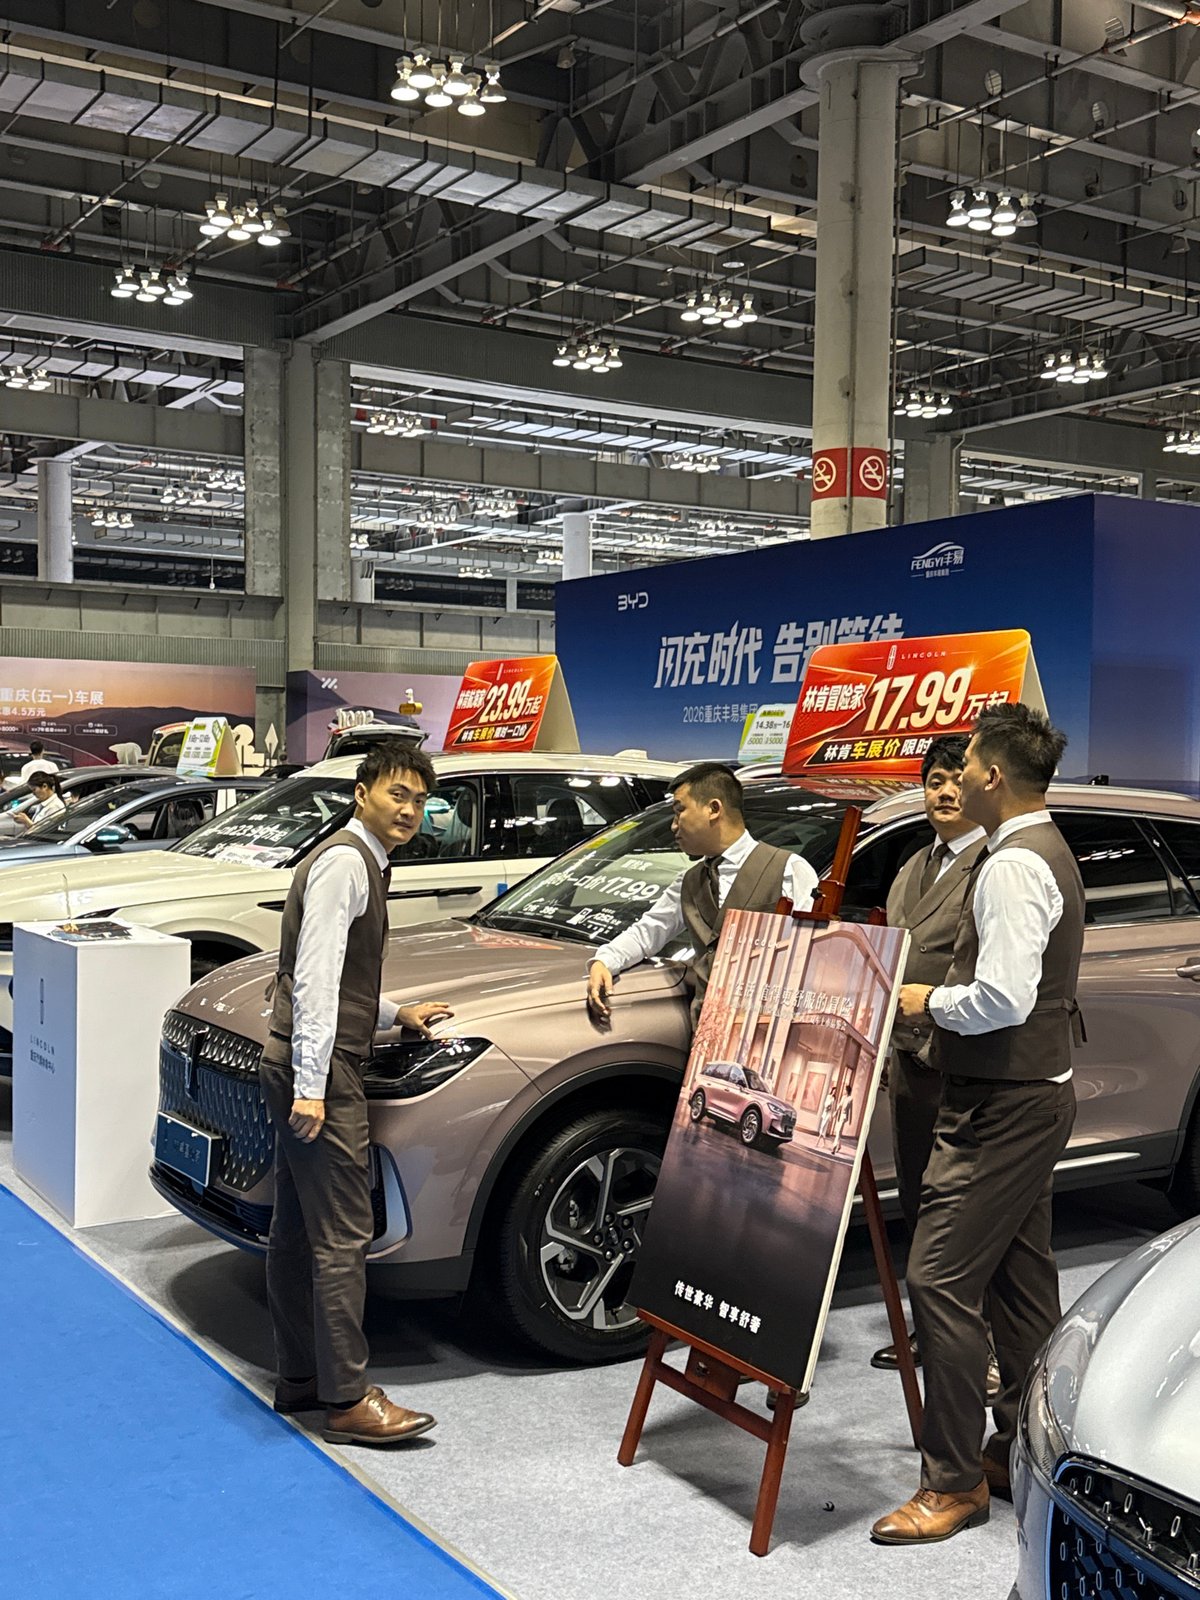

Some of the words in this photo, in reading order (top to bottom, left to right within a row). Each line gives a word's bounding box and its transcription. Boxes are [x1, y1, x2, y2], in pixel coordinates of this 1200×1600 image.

[618, 592, 649, 611] BYD
[653, 620, 763, 689] 闪充时代
[901, 651, 947, 660] LINCOLN
[801, 683, 867, 713] 林肯冒险家
[674, 1280, 714, 1310] 传世豪华
